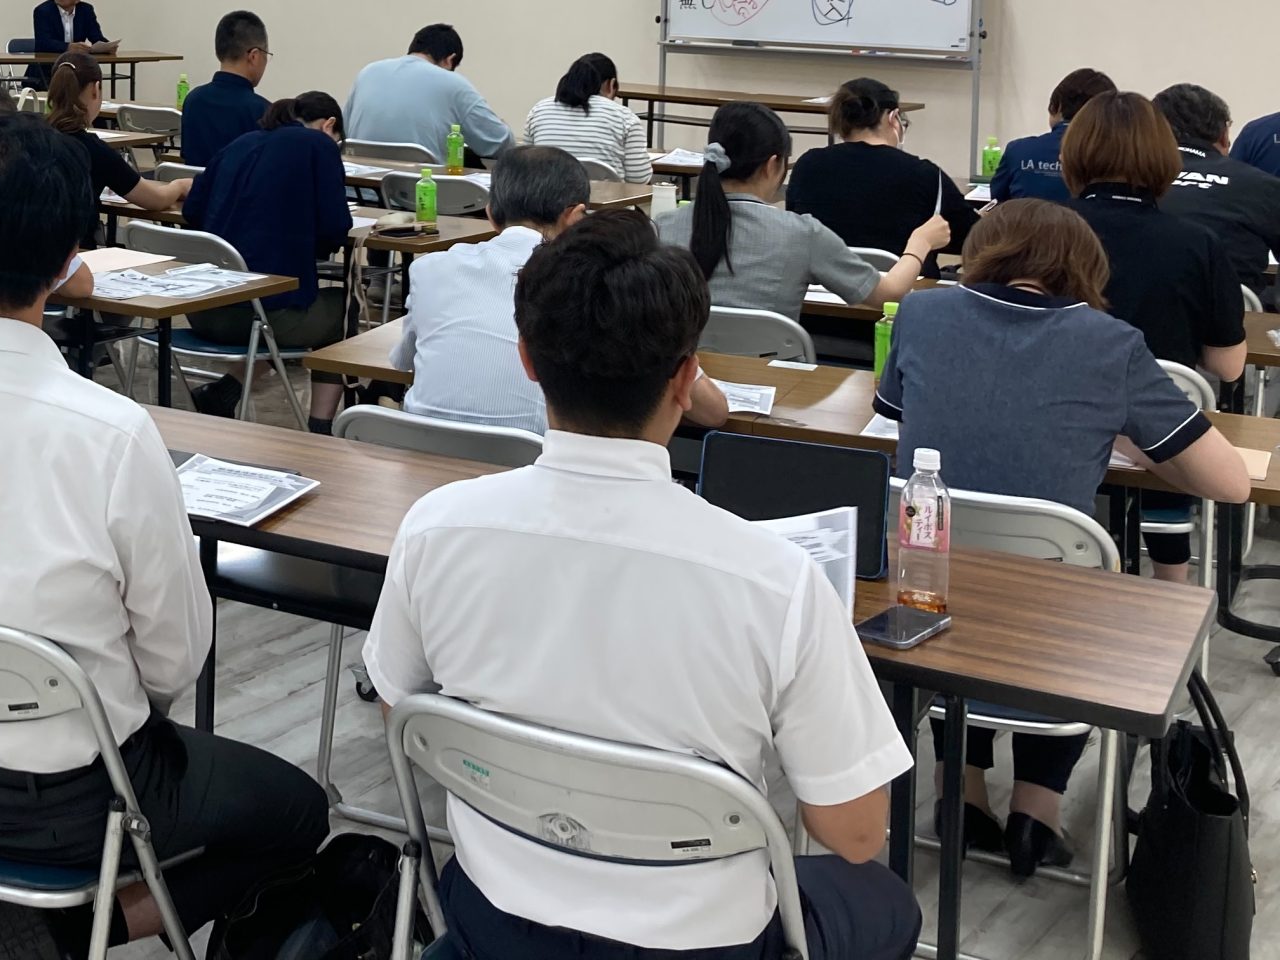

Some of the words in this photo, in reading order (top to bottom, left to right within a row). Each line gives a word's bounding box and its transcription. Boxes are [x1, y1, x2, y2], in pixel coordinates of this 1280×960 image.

[1020, 159, 1035, 170] LA
[912, 518, 923, 541] ティー
[923, 505, 933, 540] ルイボス
